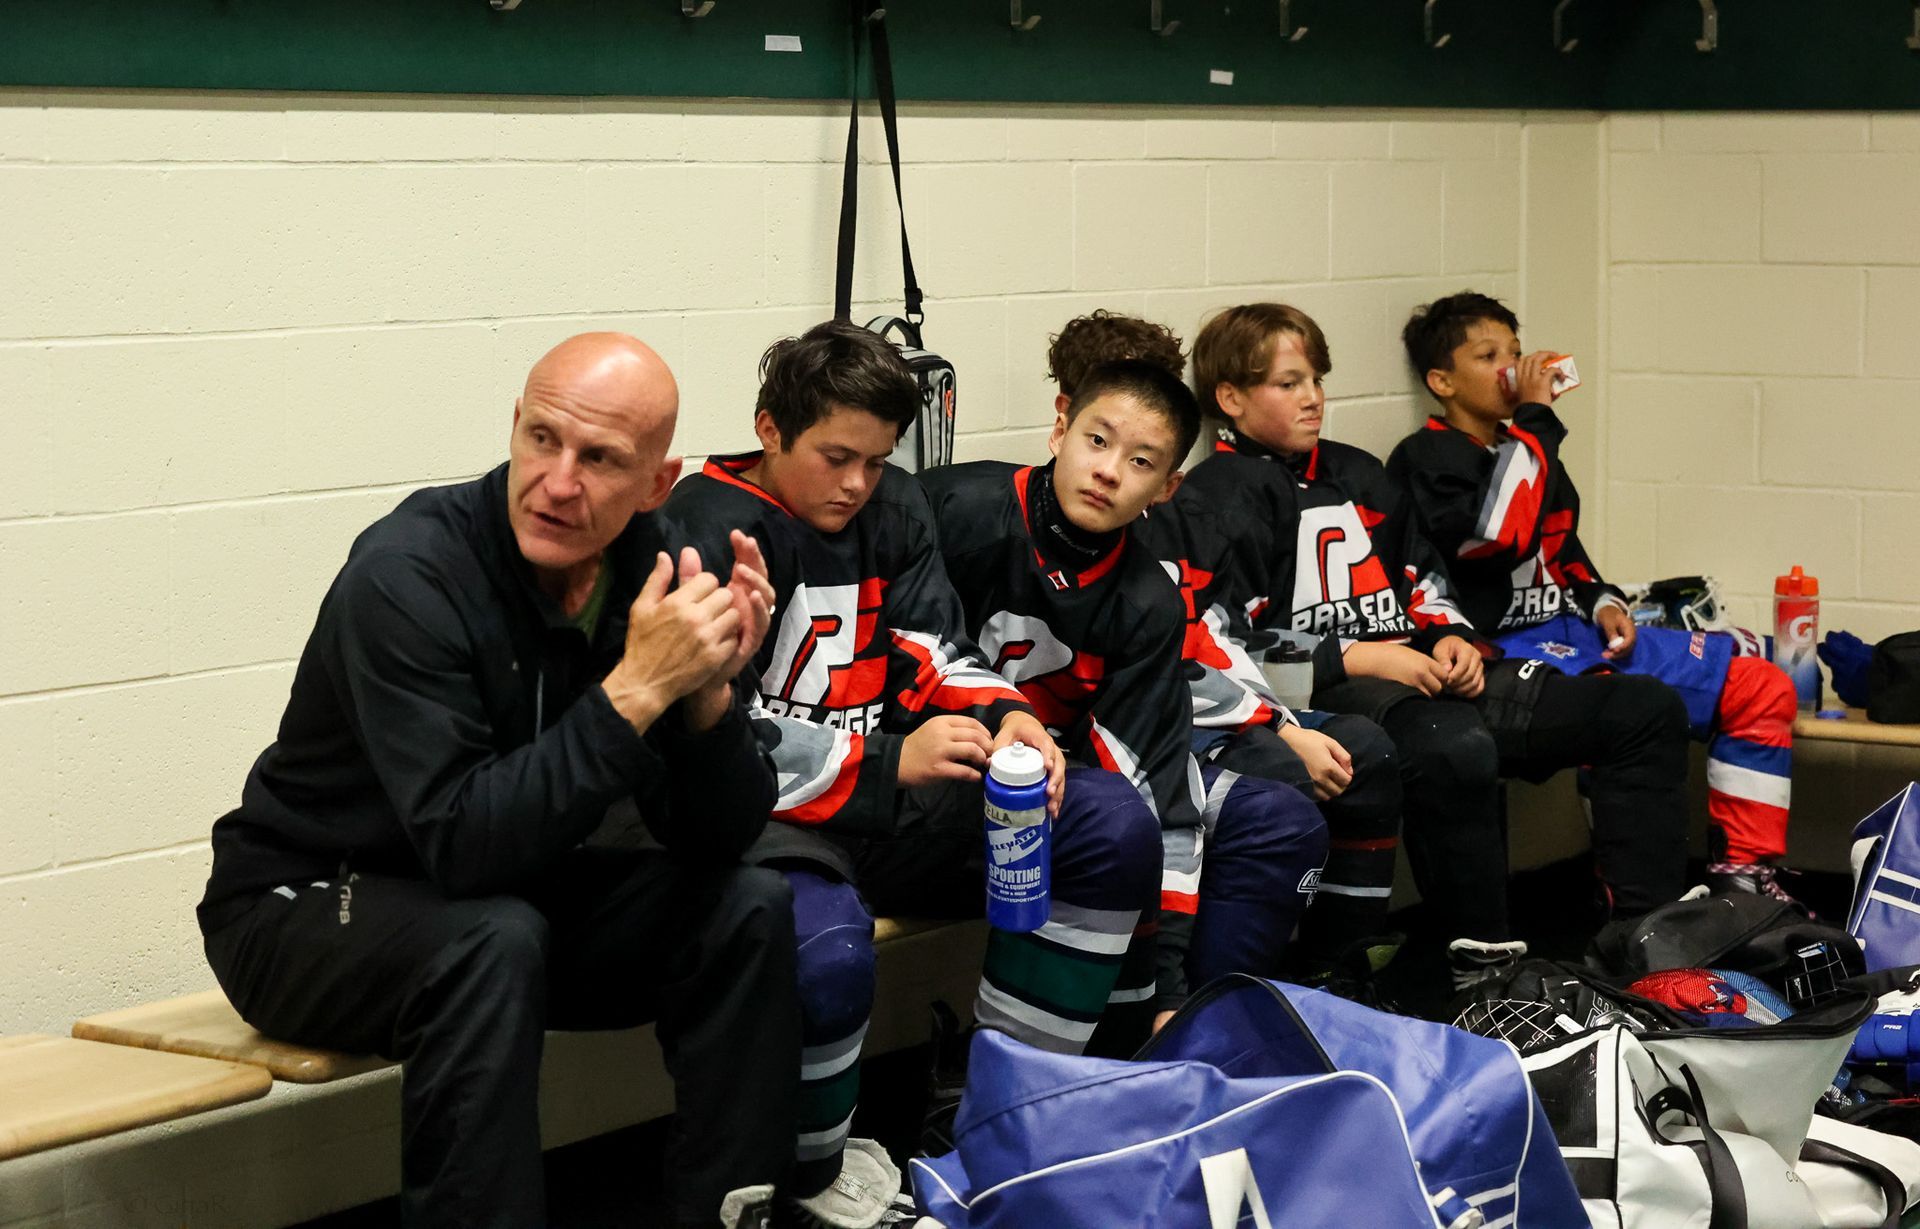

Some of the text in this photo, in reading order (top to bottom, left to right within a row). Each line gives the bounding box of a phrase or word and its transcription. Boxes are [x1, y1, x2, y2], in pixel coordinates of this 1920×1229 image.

[1506, 584, 1561, 616] PRO
[1292, 601, 1357, 634] PRO
[1789, 615, 1814, 643] G
[989, 863, 1041, 884] SPORTING
